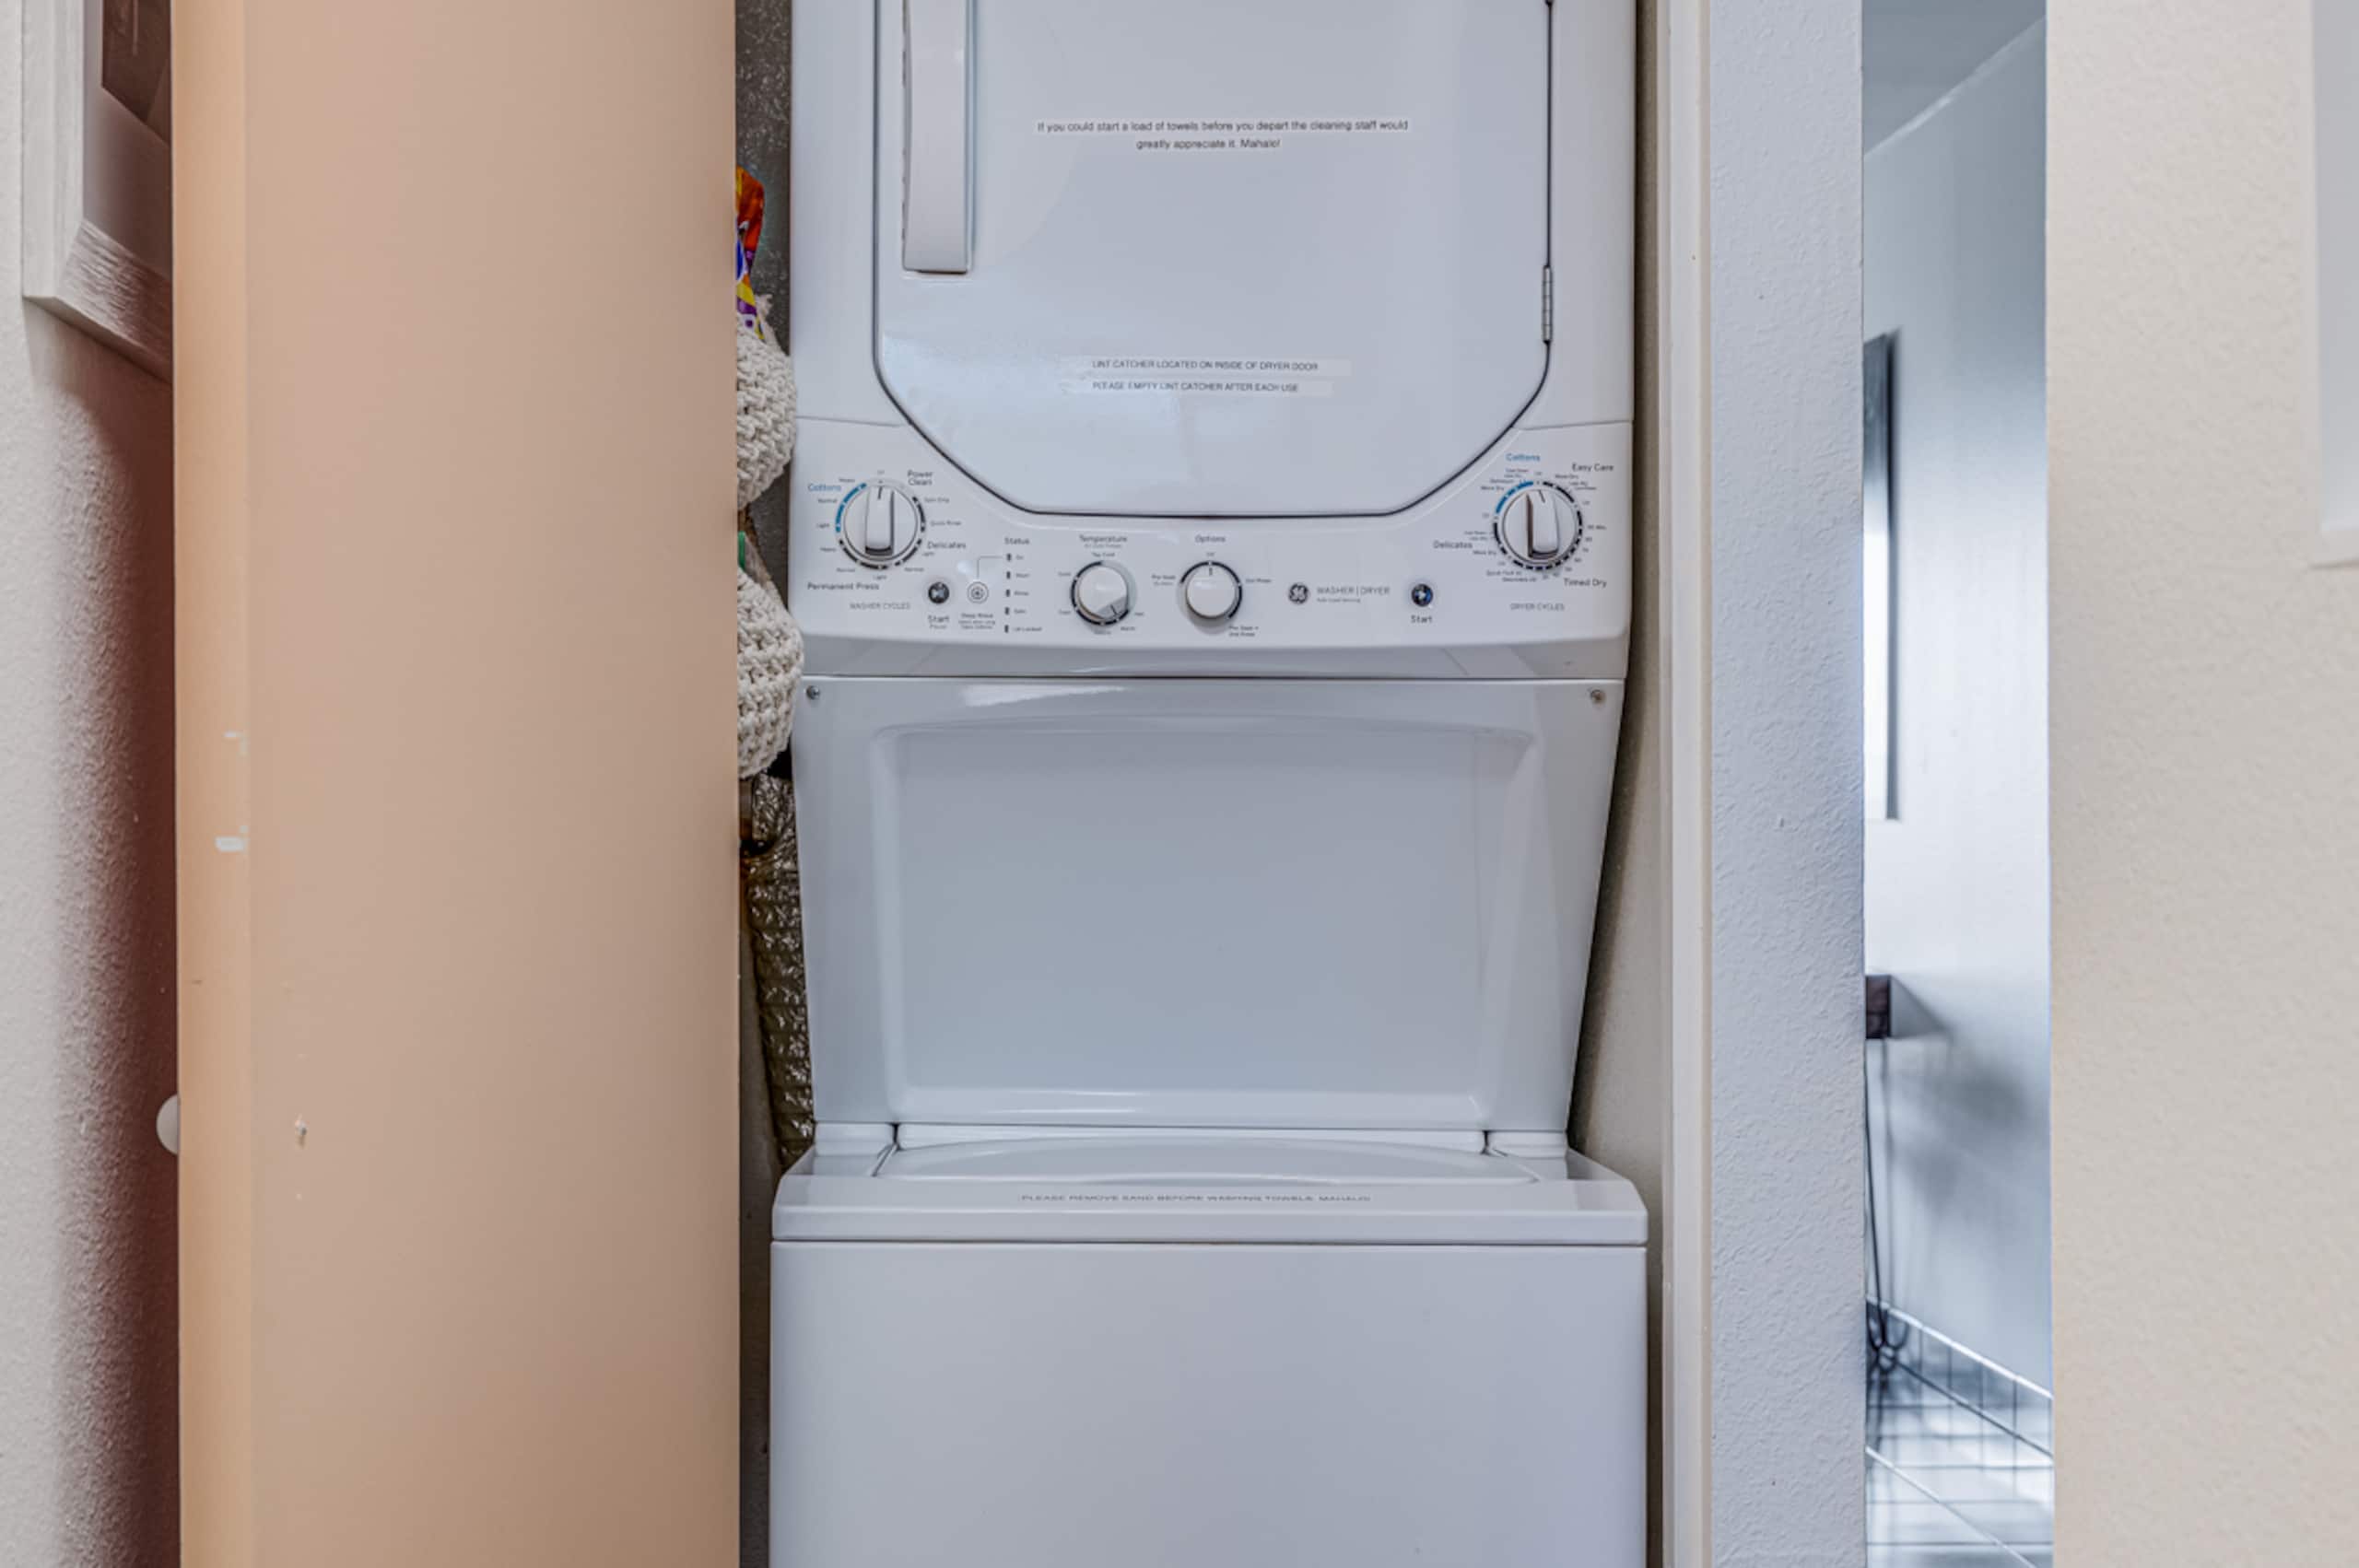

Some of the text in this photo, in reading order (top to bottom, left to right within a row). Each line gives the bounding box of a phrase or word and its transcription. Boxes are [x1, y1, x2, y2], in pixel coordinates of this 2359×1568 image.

[1047, 123, 1065, 133] you
[1067, 122, 1094, 132] could
[1097, 122, 1120, 132] start
[1121, 123, 1129, 132] a
[1131, 122, 1152, 132] load
[1155, 122, 1164, 131] of
[1167, 122, 1199, 131] towels
[1202, 121, 1234, 131] before
[1236, 123, 1254, 133] you
[1256, 121, 1288, 132] depart
[1290, 121, 1307, 130] the
[1309, 121, 1352, 132] cleaning
[1355, 120, 1377, 130] staff
[1379, 120, 1409, 130] would
[1135, 139, 1170, 150] greatly
[1173, 139, 1226, 150] appreciate
[1092, 359, 1319, 371] LINT CATCHER LOCATED ON INSIDE OF DRYER DOOR
[1092, 381, 1298, 392] PLEASE EMPTY LINT CATCHER AFTER EACH USE
[1506, 452, 1541, 462] Cottons
[1571, 462, 1614, 472] Easy Care
[908, 469, 933, 478] Power
[908, 478, 933, 486] Clean
[807, 483, 842, 492] Cottons
[1004, 537, 1030, 545] Status
[1079, 534, 1128, 544] Temperature
[1195, 534, 1226, 544] Options
[927, 541, 967, 550] Delicates
[1433, 540, 1473, 550] Delicates
[807, 581, 880, 591] Permanent Press
[1564, 577, 1608, 590] Timed Dry
[1316, 586, 1391, 597] WASHER DRYER
[850, 602, 911, 611] WASHER CYCLES
[1509, 602, 1565, 611] DRYER CYCLES
[927, 614, 950, 624] Start
[1411, 613, 1433, 625] Start
[1020, 1194, 1064, 1202] PLEASE
[1068, 1194, 1119, 1202] REMOVE
[1121, 1194, 1155, 1202] SAND
[1156, 1194, 1203, 1202] BEFORE
[1206, 1194, 1263, 1203] WASHING
